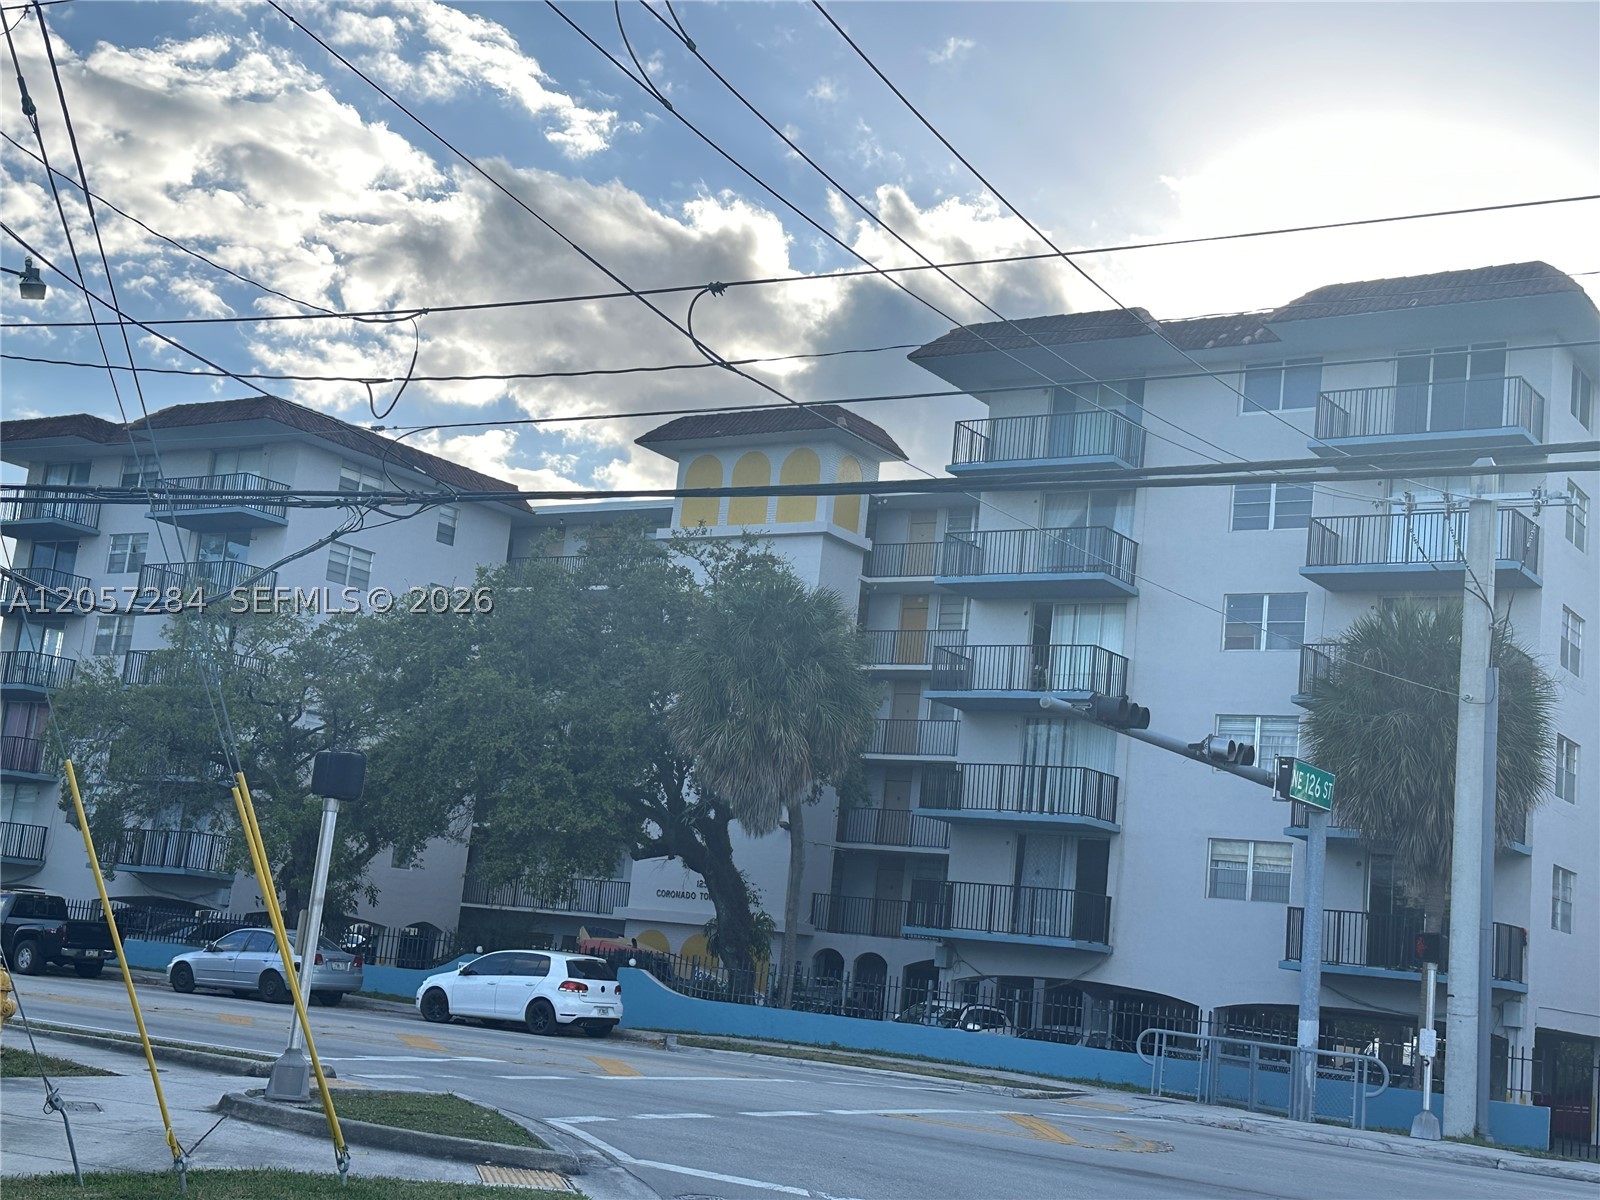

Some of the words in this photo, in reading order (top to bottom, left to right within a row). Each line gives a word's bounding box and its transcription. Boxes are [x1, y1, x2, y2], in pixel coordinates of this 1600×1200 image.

[1291, 769, 1304, 789] NE
[1305, 773, 1321, 798] 126
[1323, 781, 1333, 800] ST
[656, 889, 697, 900] CORONADO
